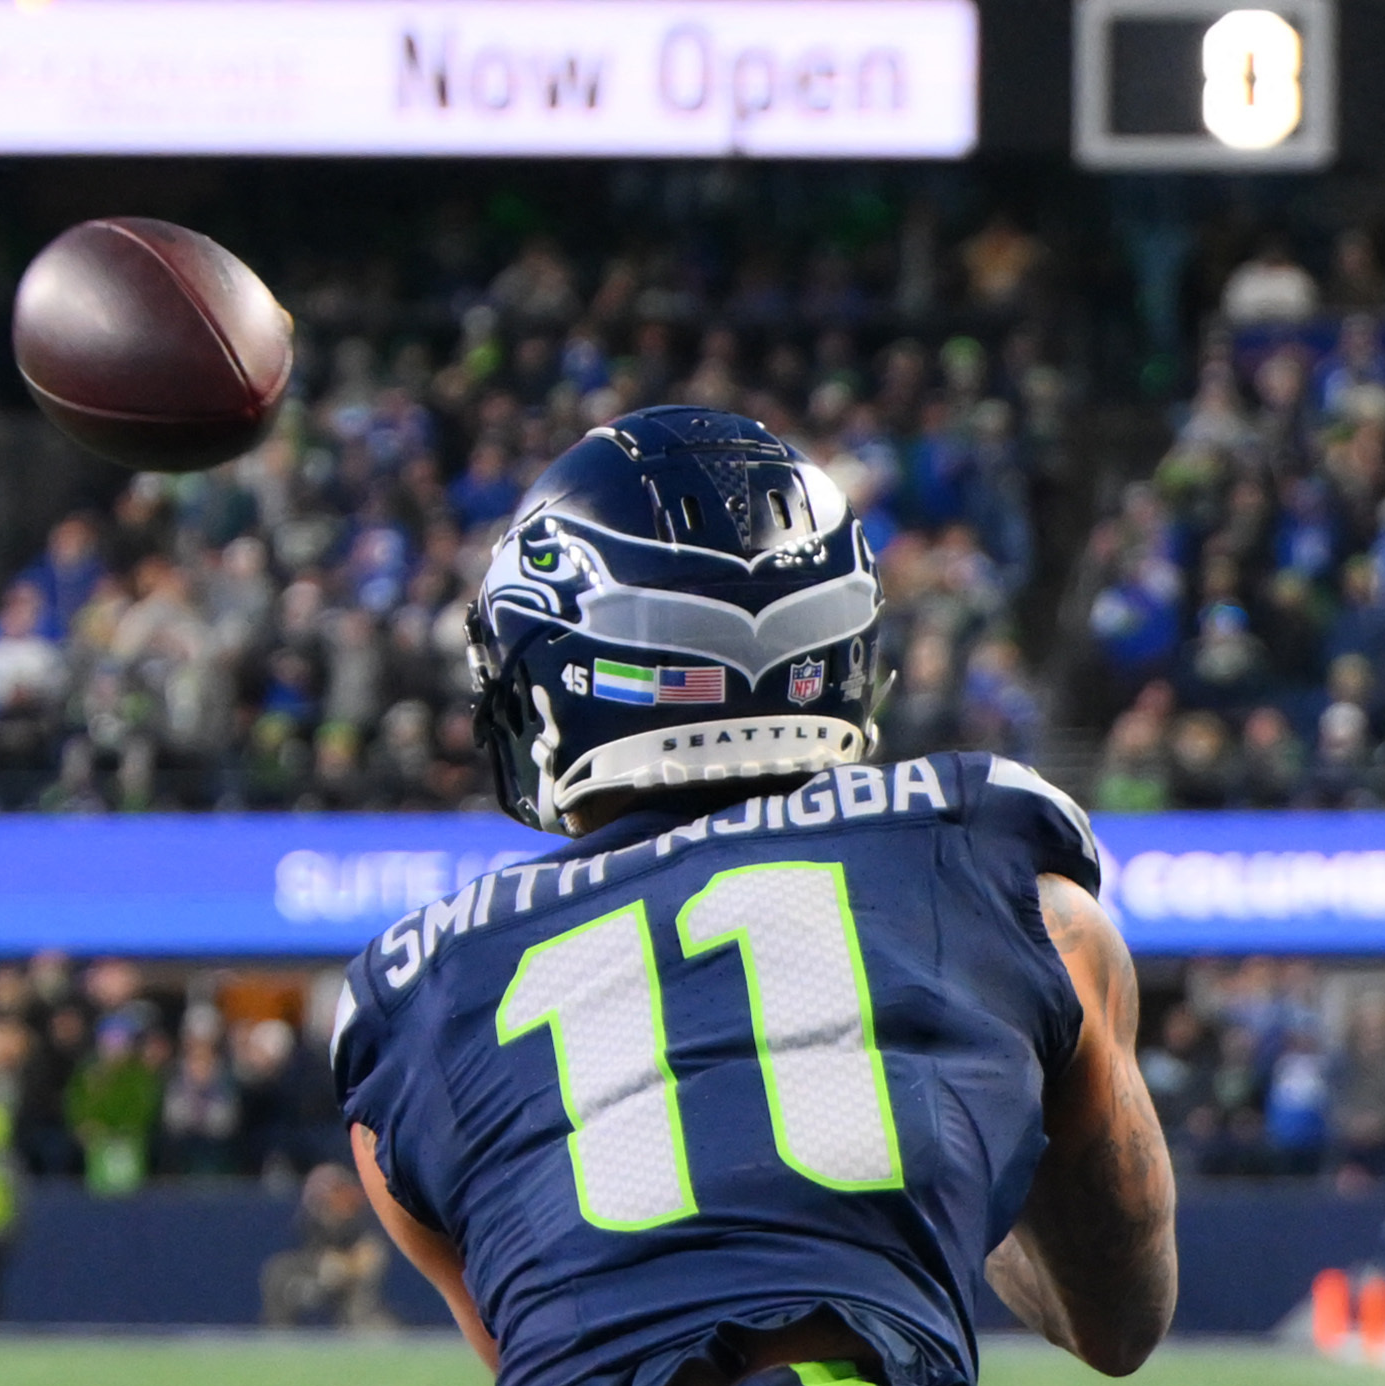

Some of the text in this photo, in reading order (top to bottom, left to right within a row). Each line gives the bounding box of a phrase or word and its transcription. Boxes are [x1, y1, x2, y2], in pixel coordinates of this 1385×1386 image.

[397, 30, 604, 110] Now
[659, 22, 903, 150] Open
[560, 662, 589, 696] 45
[792, 678, 820, 699] NFL
[662, 725, 828, 752] SEATTLE
[496, 861, 904, 1232] 11
